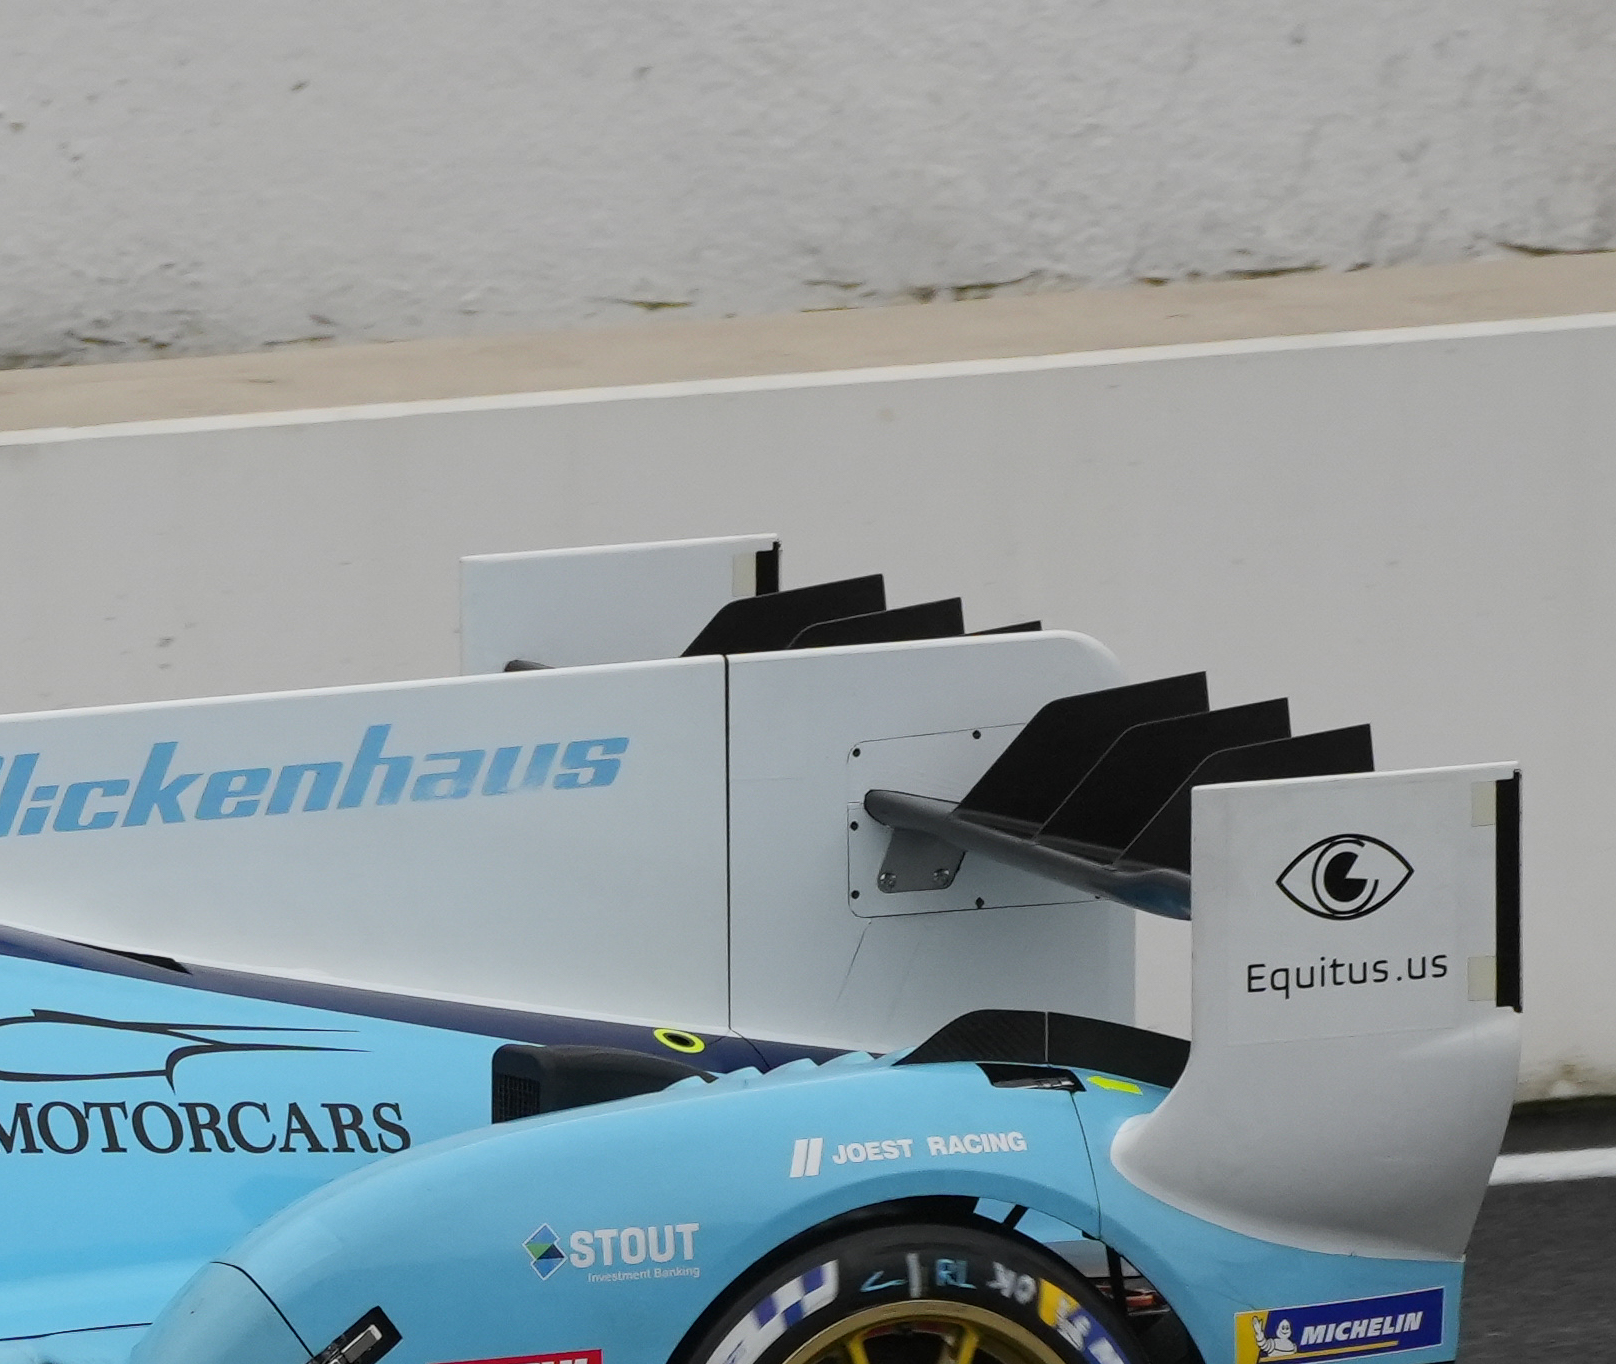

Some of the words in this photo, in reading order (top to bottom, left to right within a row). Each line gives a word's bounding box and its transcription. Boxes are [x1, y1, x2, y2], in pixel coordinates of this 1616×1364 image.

[1246, 948, 1448, 999] Equitus.us
[832, 1138, 914, 1166] JOEST
[926, 1130, 1028, 1158] RACING
[569, 1222, 700, 1269] STOUT
[587, 1270, 652, 1283] Investment
[654, 1266, 701, 1279] Banking
[1299, 1310, 1424, 1345] MICHELIN
